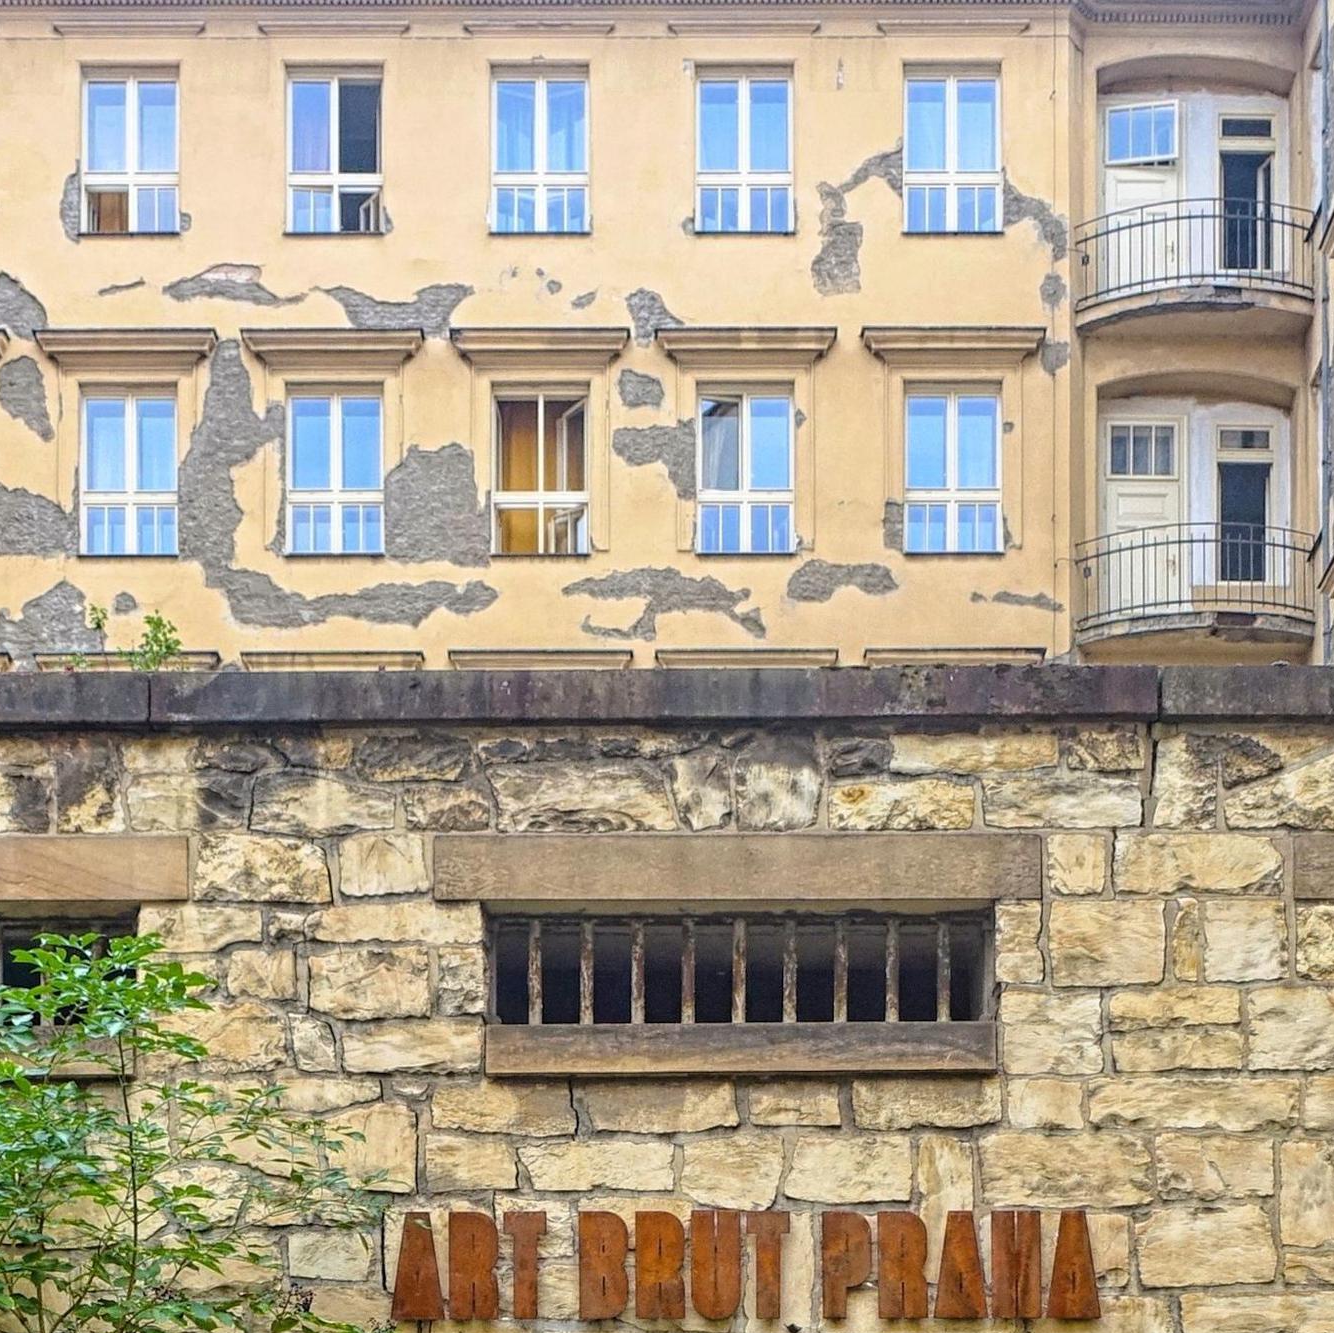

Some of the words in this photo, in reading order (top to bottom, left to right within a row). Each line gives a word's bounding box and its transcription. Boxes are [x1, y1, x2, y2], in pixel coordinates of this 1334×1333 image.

[390, 1210, 548, 1321] ART
[578, 1209, 791, 1321] BRUT
[822, 1209, 1102, 1321] PRAHA
